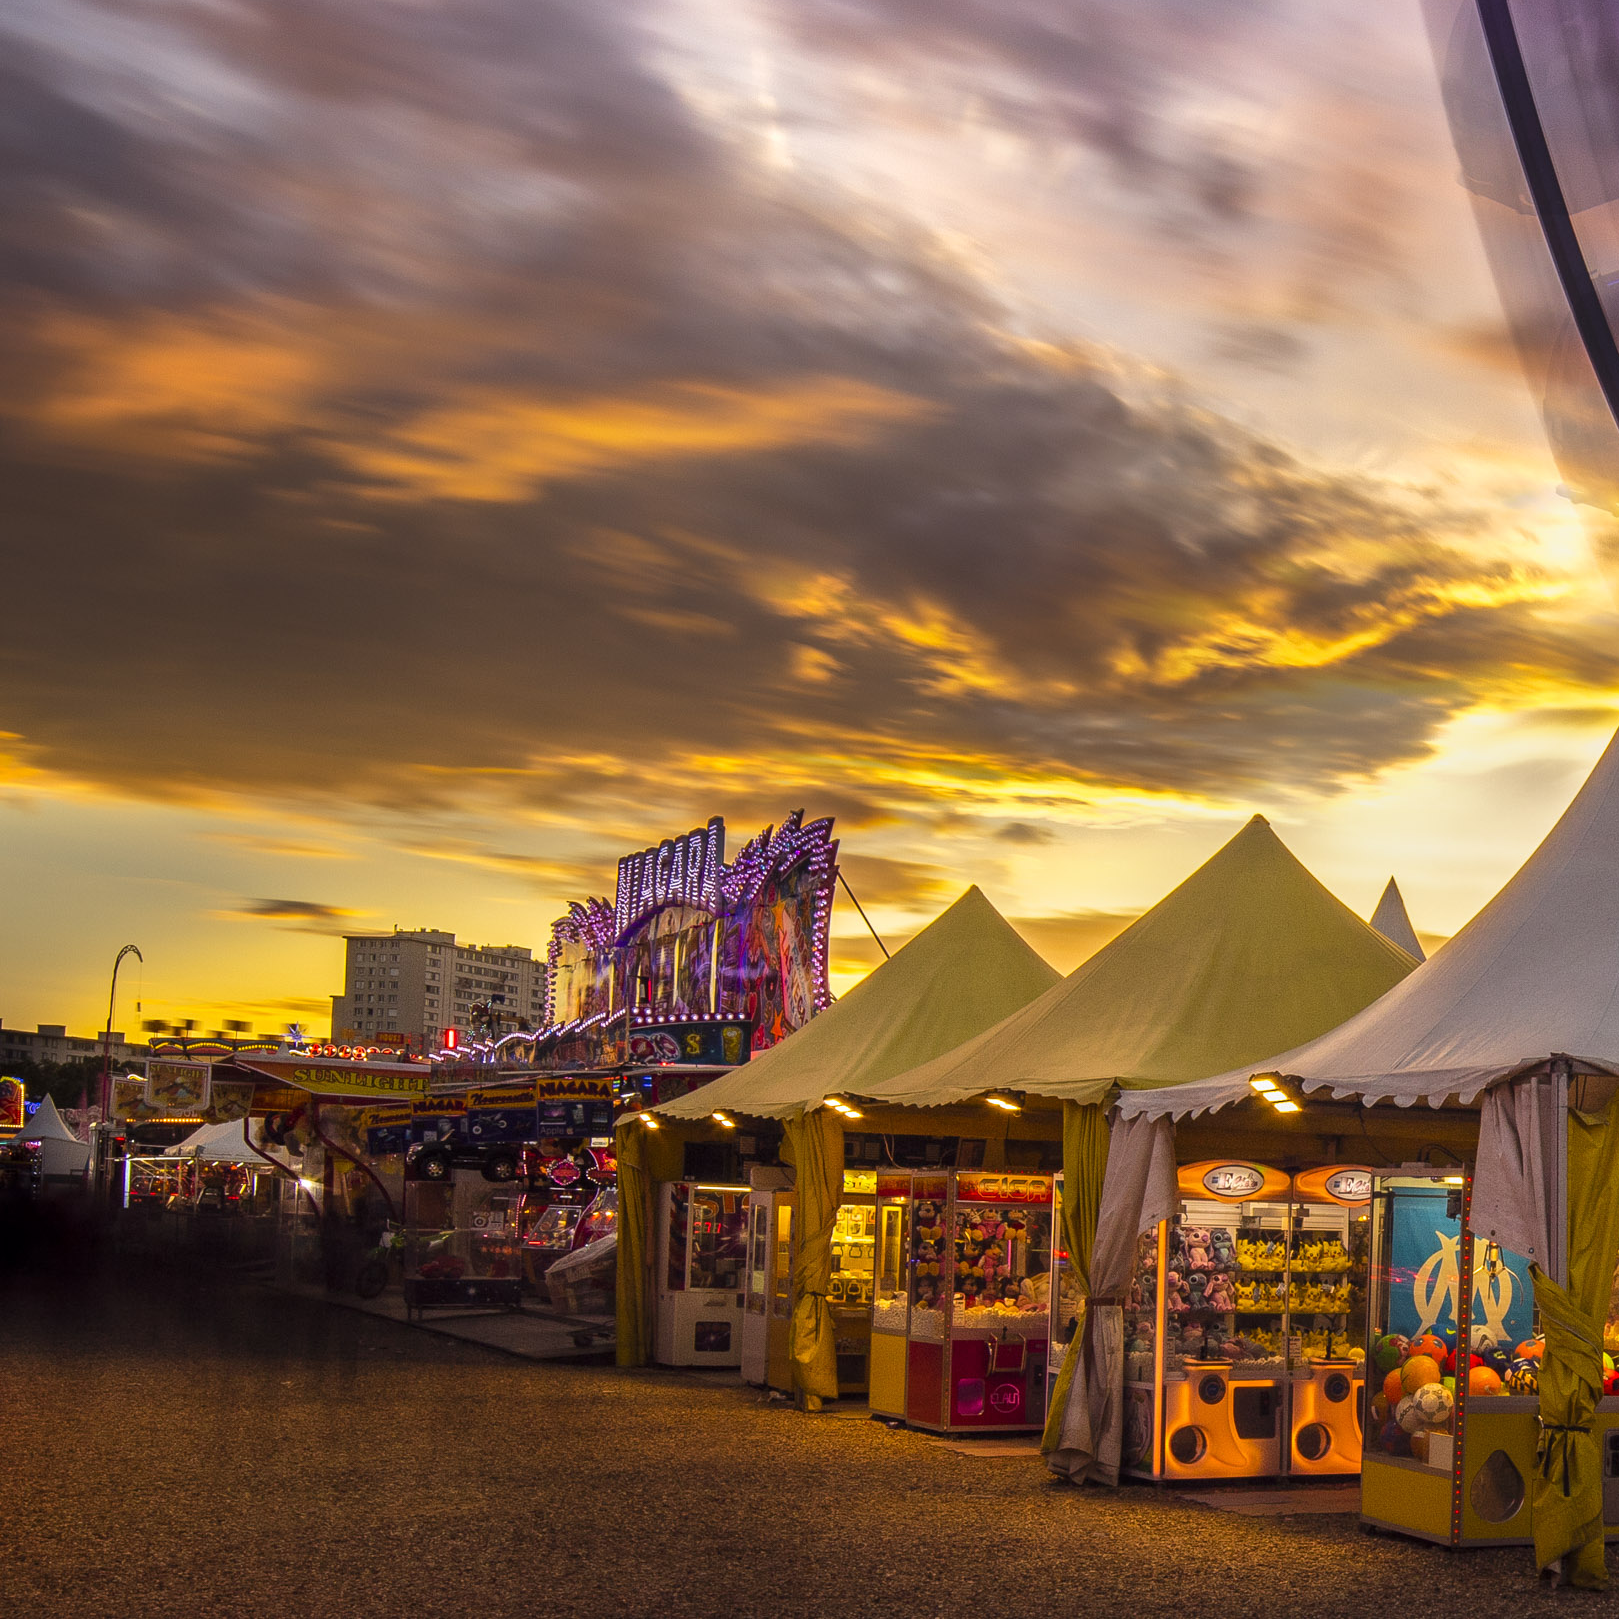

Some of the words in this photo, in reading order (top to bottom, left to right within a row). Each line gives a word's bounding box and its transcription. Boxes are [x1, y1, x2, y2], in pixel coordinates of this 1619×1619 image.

[293, 1068, 428, 1092] SUNLIGHT
[539, 1081, 611, 1098] NIAGARA
[977, 1177, 1047, 1202] GIGA
